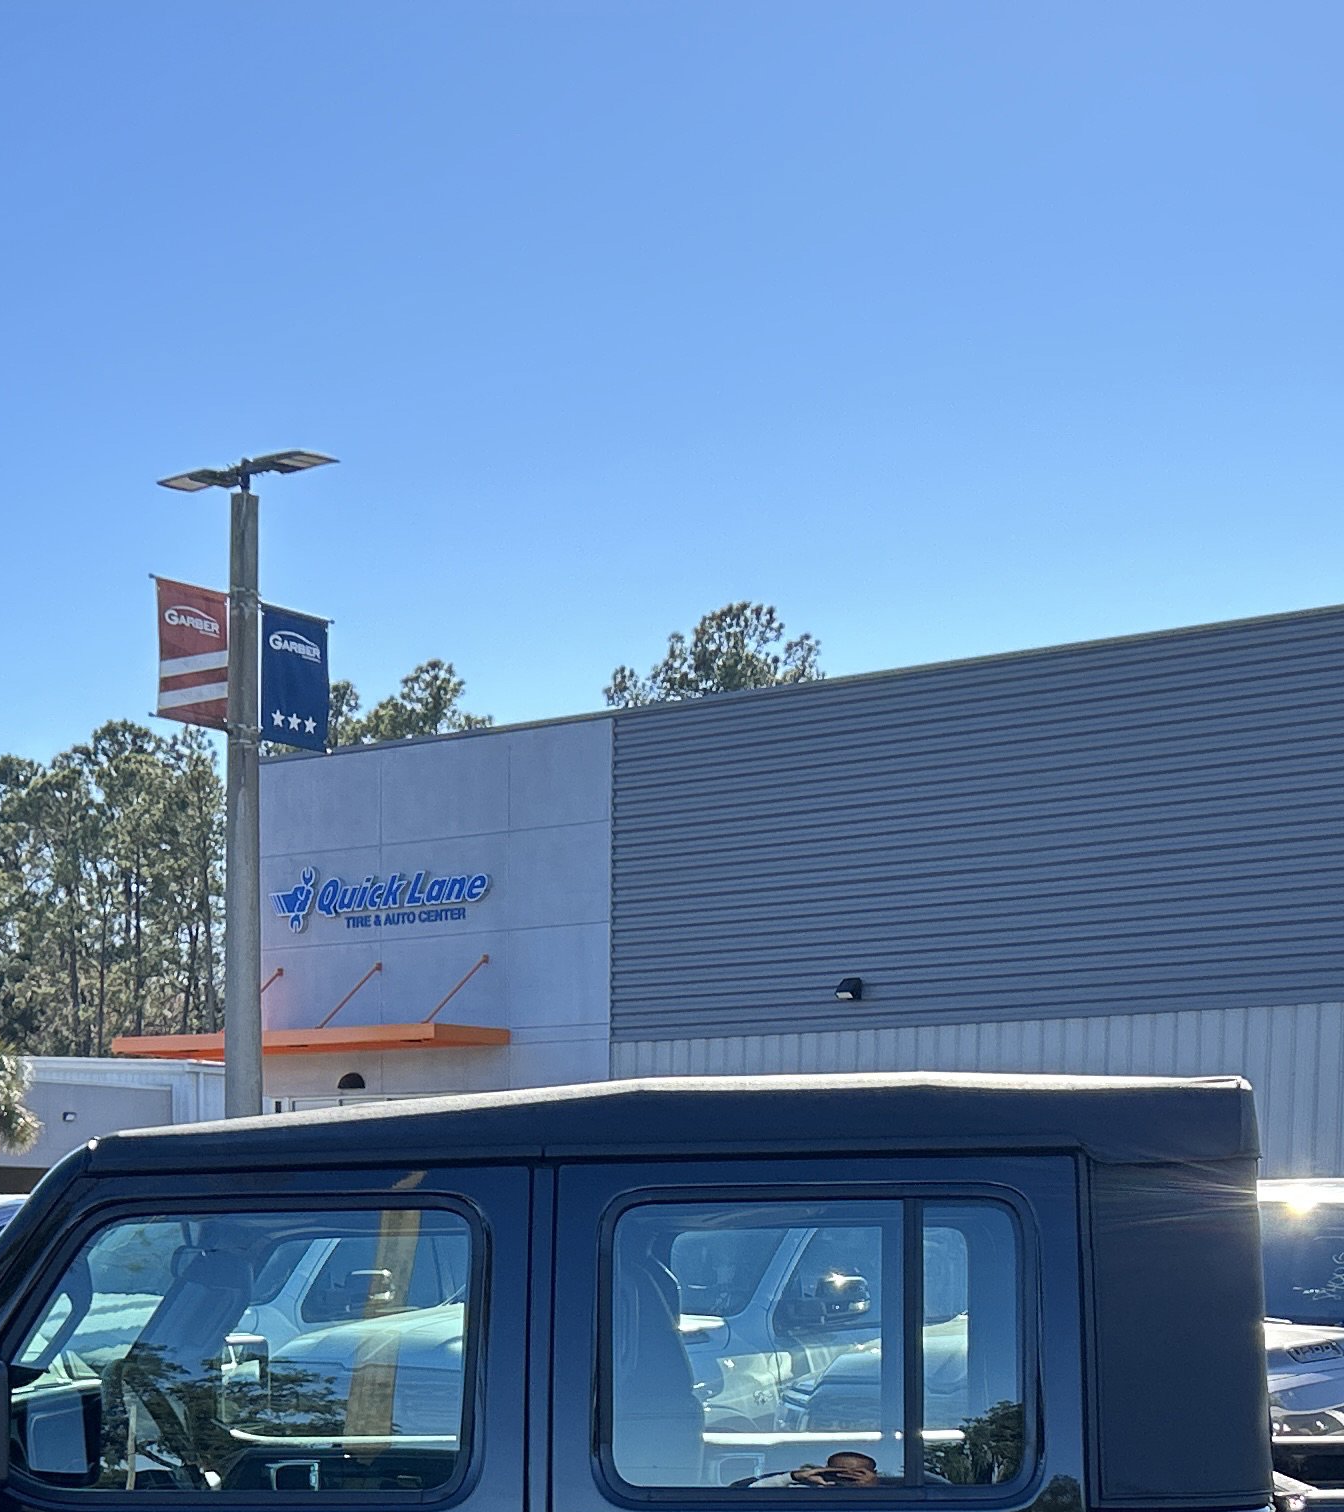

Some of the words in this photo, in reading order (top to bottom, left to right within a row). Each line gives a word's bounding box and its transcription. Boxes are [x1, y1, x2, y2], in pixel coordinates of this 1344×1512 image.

[164, 609, 220, 635] GARBER
[269, 634, 321, 660] GARBER
[316, 872, 406, 917] Quick
[406, 870, 488, 907] Lane
[345, 915, 371, 929] TIRE
[373, 916, 381, 927] &
[383, 911, 416, 926] AUTO
[417, 907, 467, 924] CENTER
